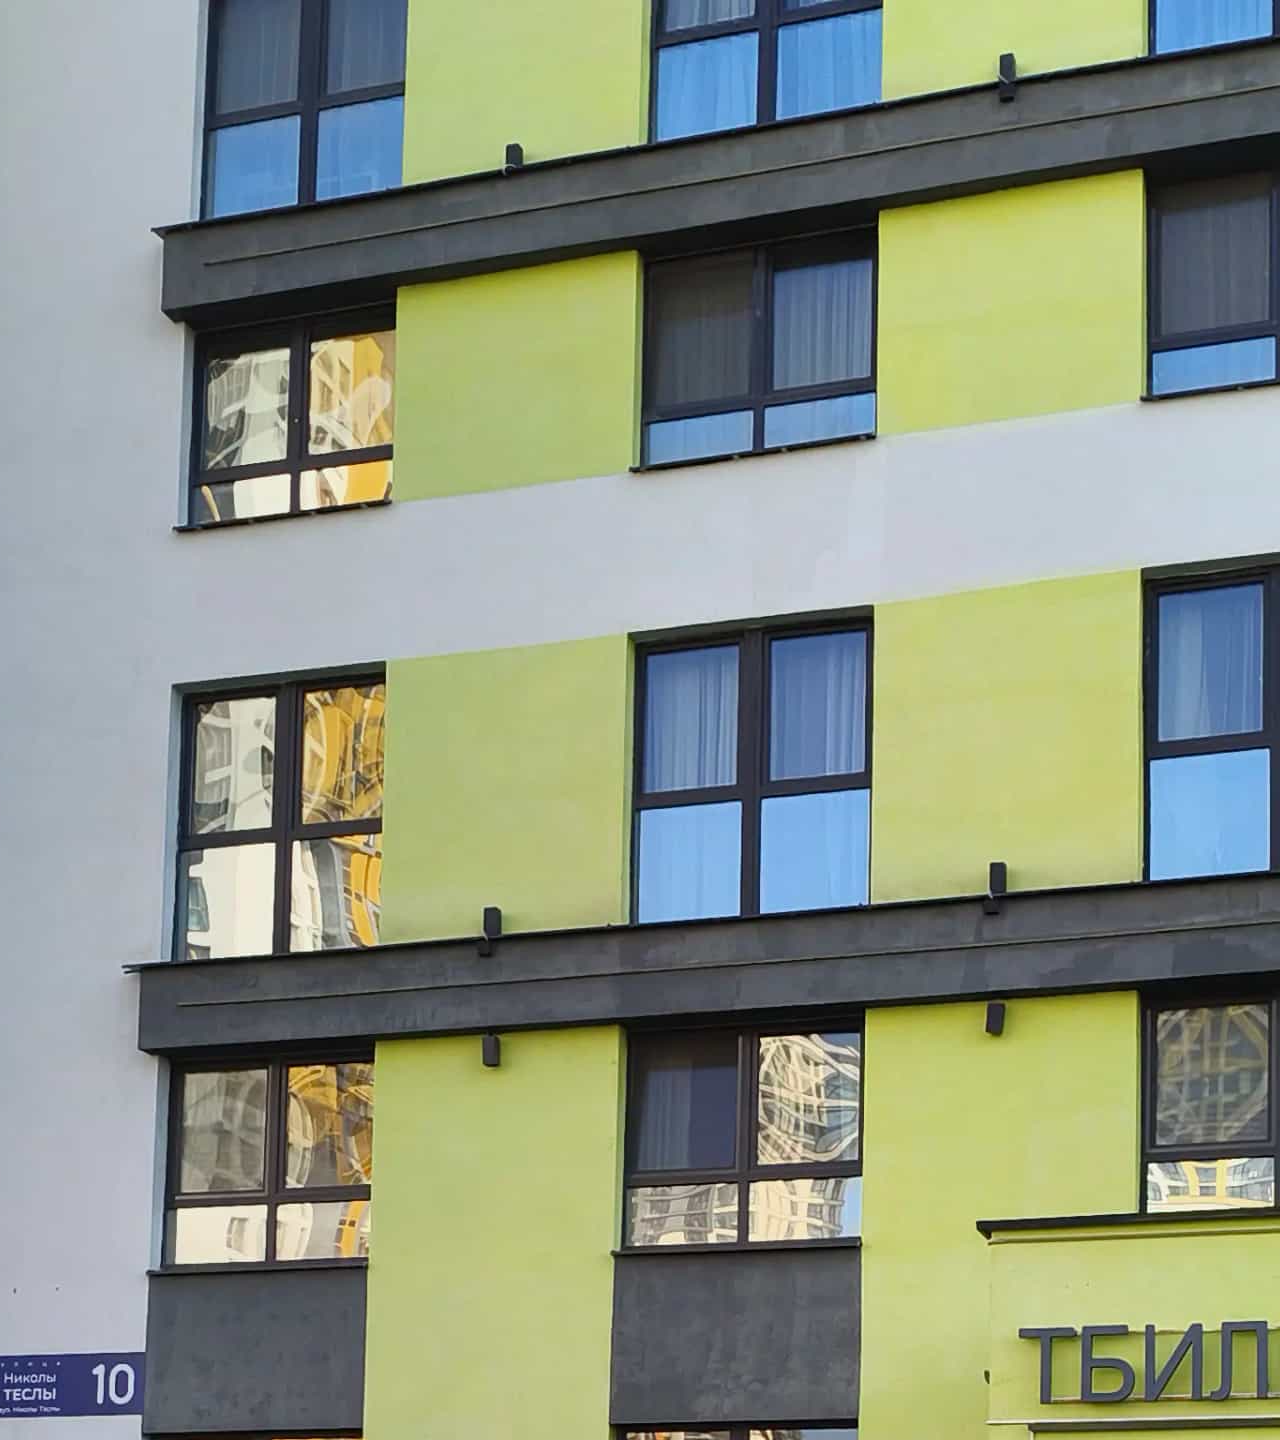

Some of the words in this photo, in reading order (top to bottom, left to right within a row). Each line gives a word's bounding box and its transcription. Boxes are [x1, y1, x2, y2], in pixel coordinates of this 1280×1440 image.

[3, 1372, 57, 1384] Николы
[91, 1363, 135, 1405] 10
[2, 1387, 57, 1401] ТЕСЛЫ
